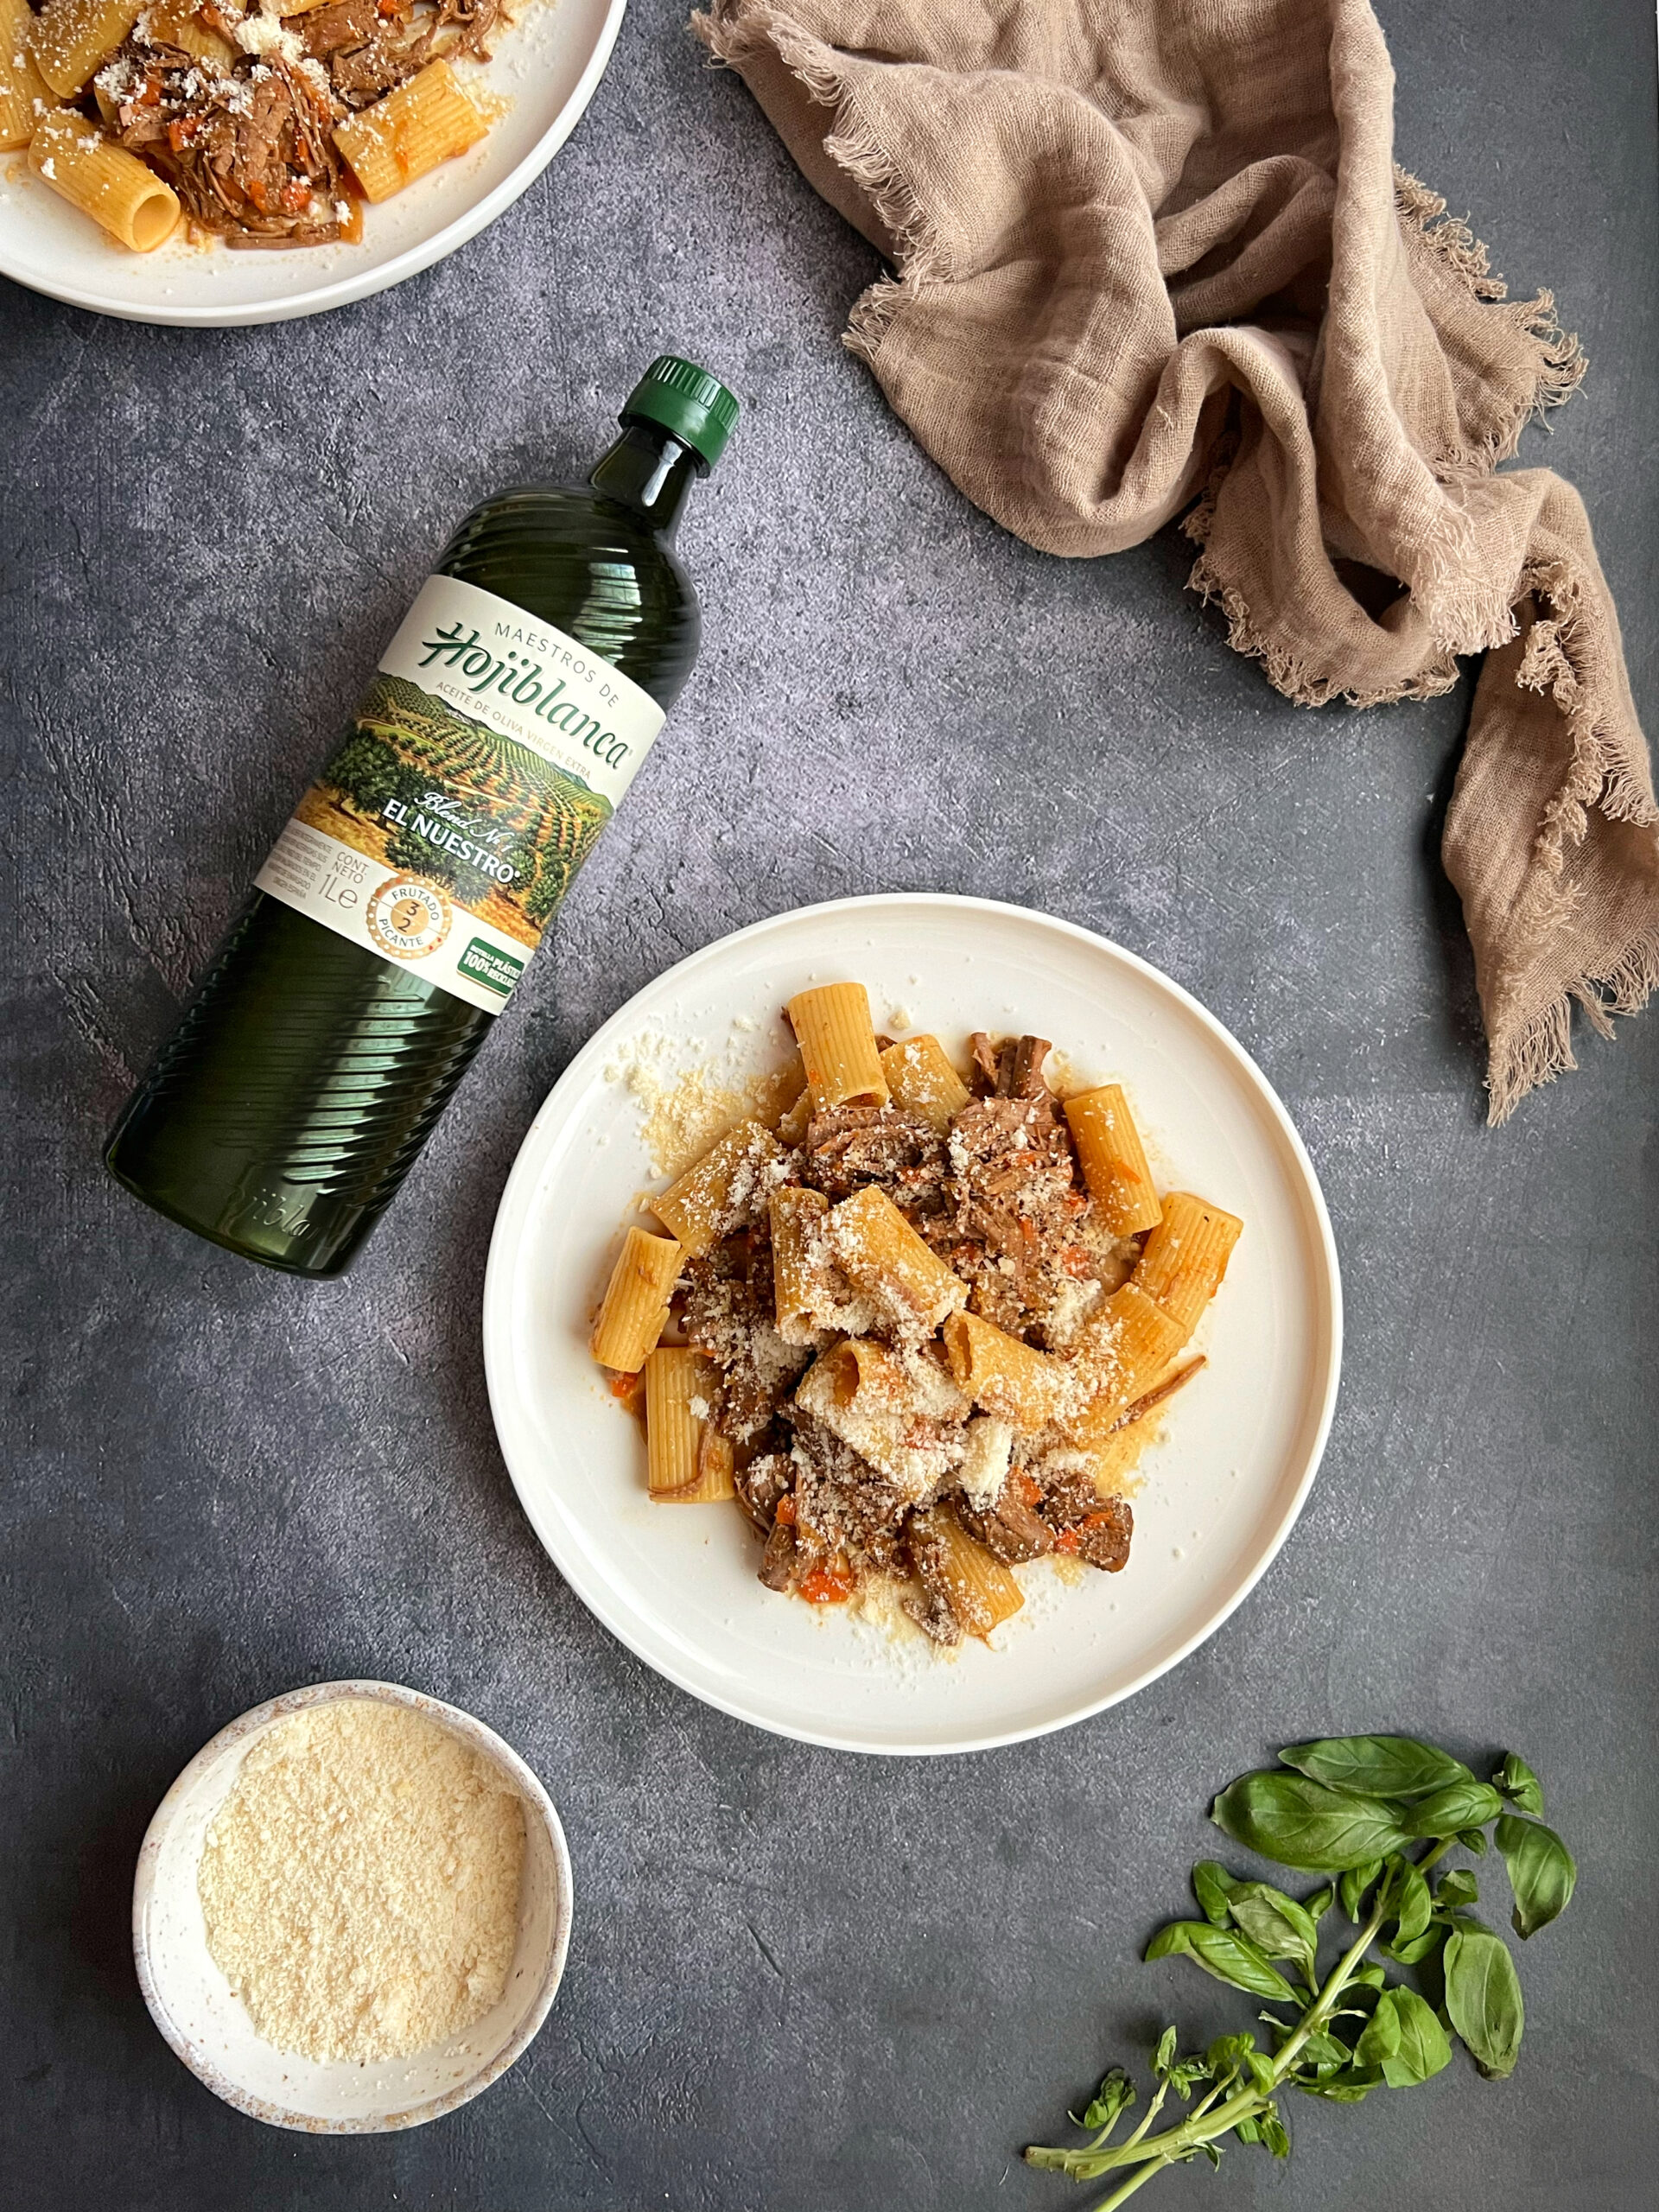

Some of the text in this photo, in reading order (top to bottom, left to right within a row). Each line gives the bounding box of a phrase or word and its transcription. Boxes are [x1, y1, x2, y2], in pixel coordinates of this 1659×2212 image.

[494, 622, 620, 708] MAESTROS DE
[435, 682, 591, 779] ACEITE DE OLIVA VIRGEN EXTRA
[414, 791, 482, 830] Blend
[382, 798, 515, 884] EL NUESTRO
[332, 861, 364, 884] NETO
[337, 851, 370, 876] CONT.
[391, 887, 440, 921] FRUTADO
[406, 900, 421, 916] 3
[378, 918, 424, 948] PICANTE
[397, 917, 411, 933] 2
[463, 950, 492, 974] 100%
